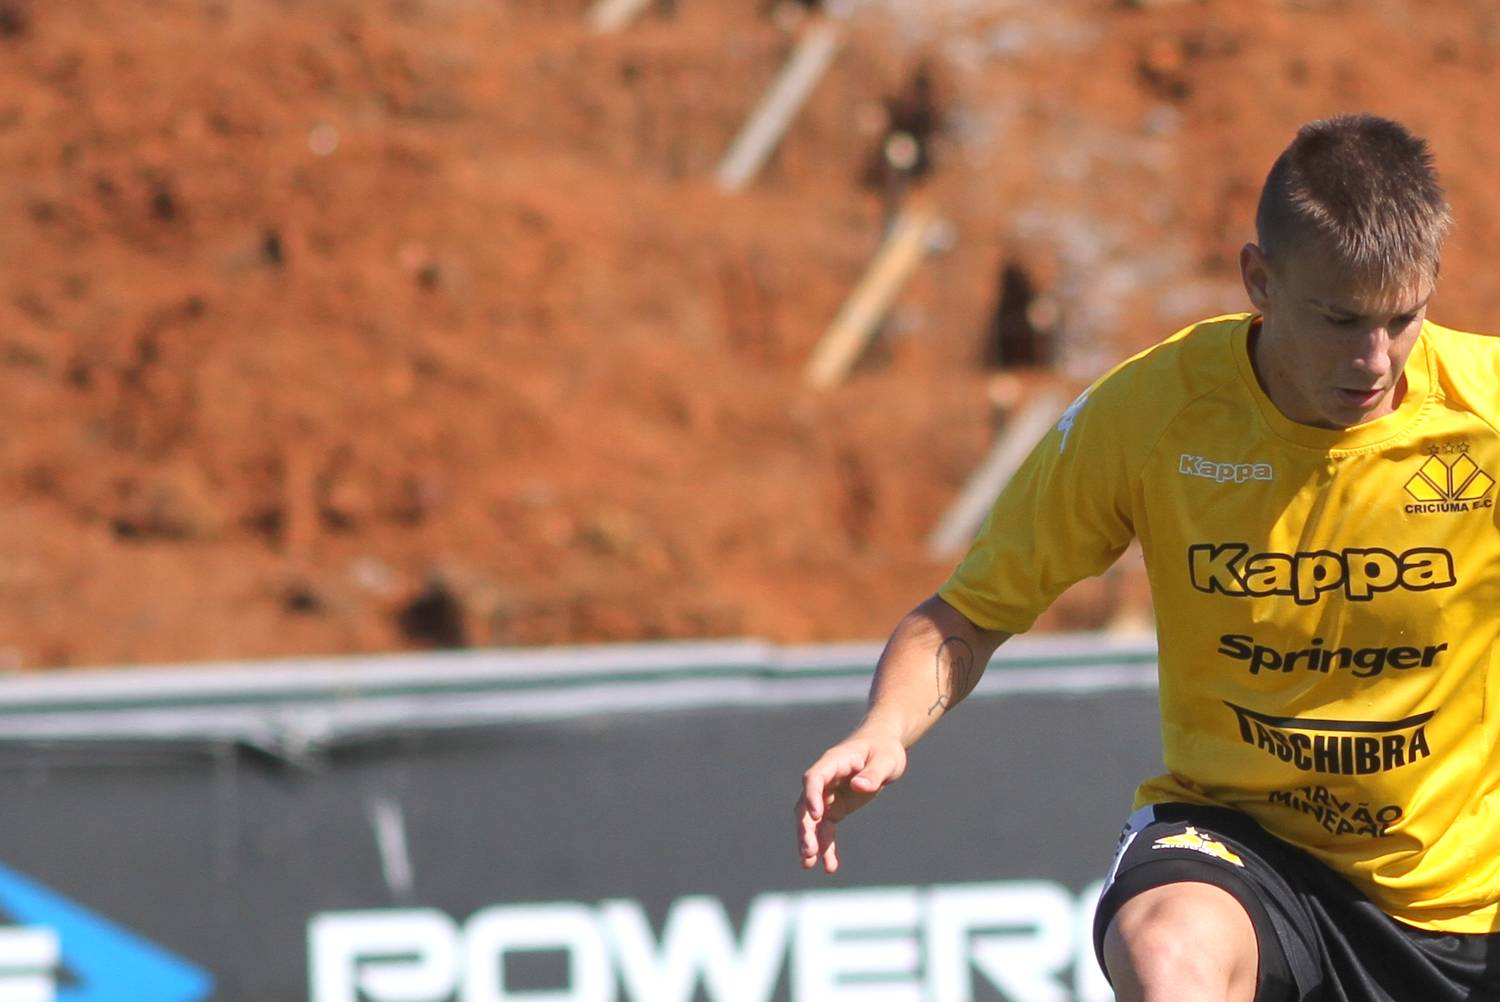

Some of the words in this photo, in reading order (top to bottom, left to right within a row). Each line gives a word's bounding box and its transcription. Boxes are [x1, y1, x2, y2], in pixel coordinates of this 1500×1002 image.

[1179, 454, 1273, 483] Kappa
[1187, 543, 1457, 605] Kappa
[1217, 633, 1448, 678] Springer
[1221, 700, 1437, 775] TASCHIBRA
